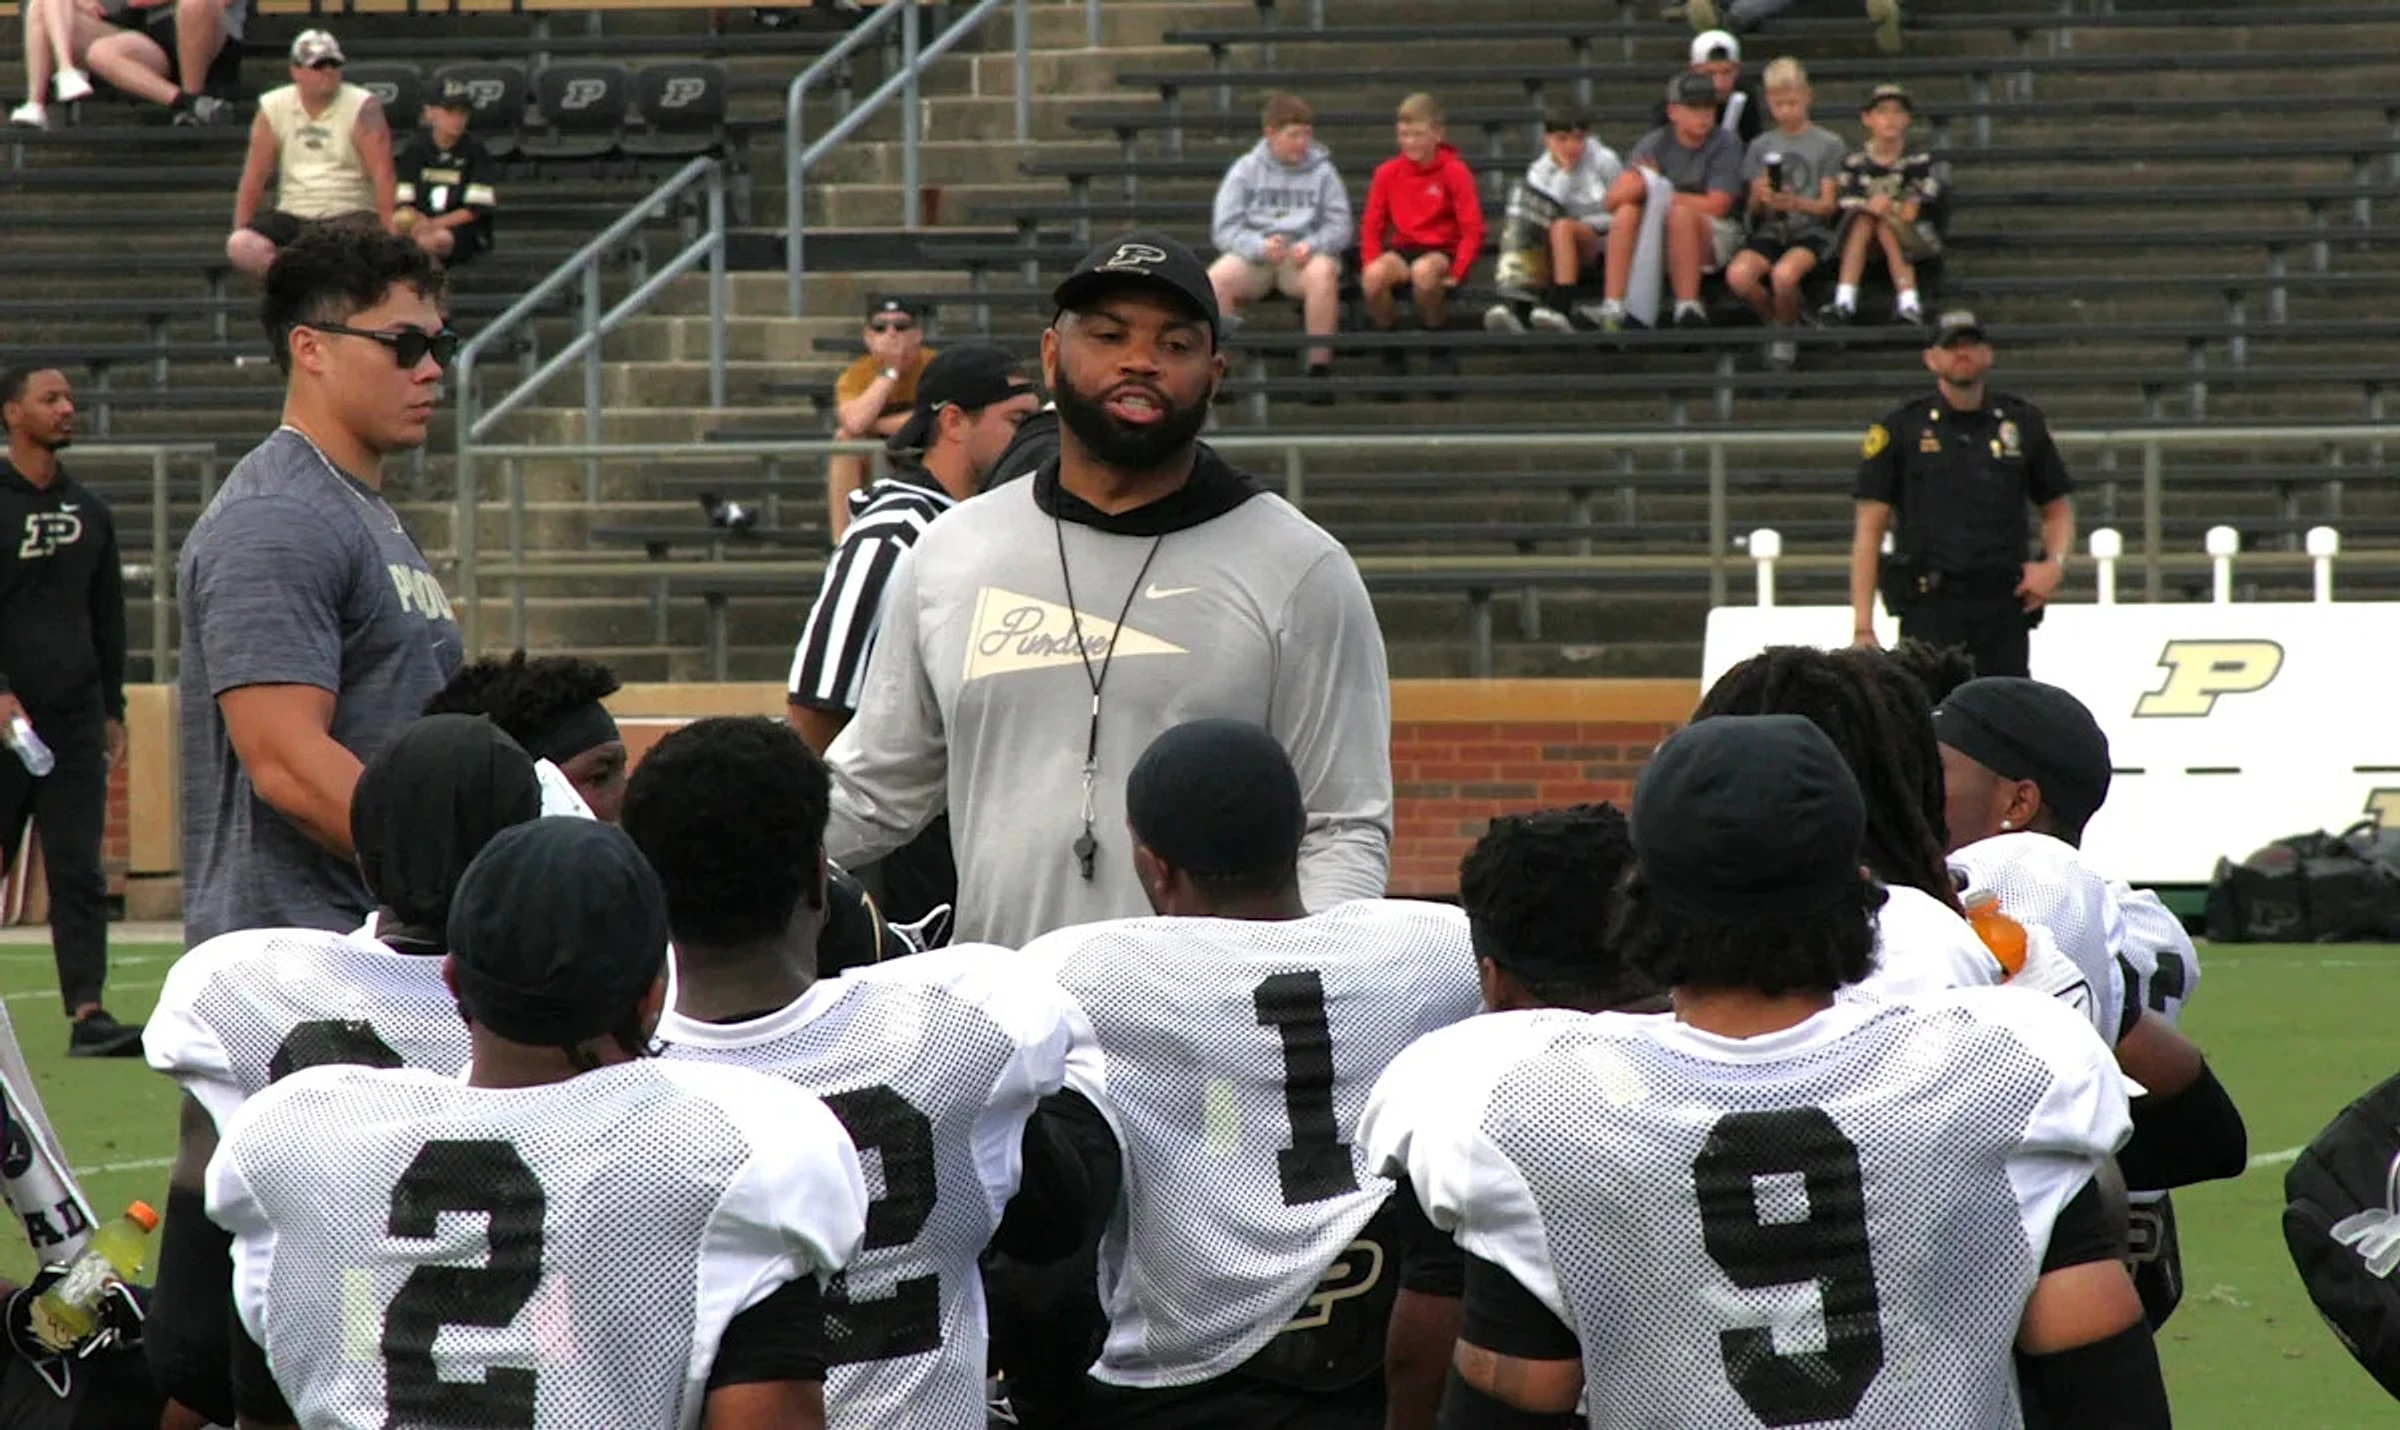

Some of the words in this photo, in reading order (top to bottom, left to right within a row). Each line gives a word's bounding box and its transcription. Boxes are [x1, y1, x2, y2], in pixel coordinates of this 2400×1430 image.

[561, 79, 606, 109] P
[660, 78, 705, 107] P
[1107, 244, 1167, 266] P
[19, 512, 82, 559] P
[979, 606, 1111, 657] Purdue
[2131, 639, 2285, 718] P
[1254, 970, 1360, 1207] 1
[817, 1084, 943, 1370] 2
[382, 1140, 546, 1430] 2
[1693, 1106, 1884, 1428] 9
